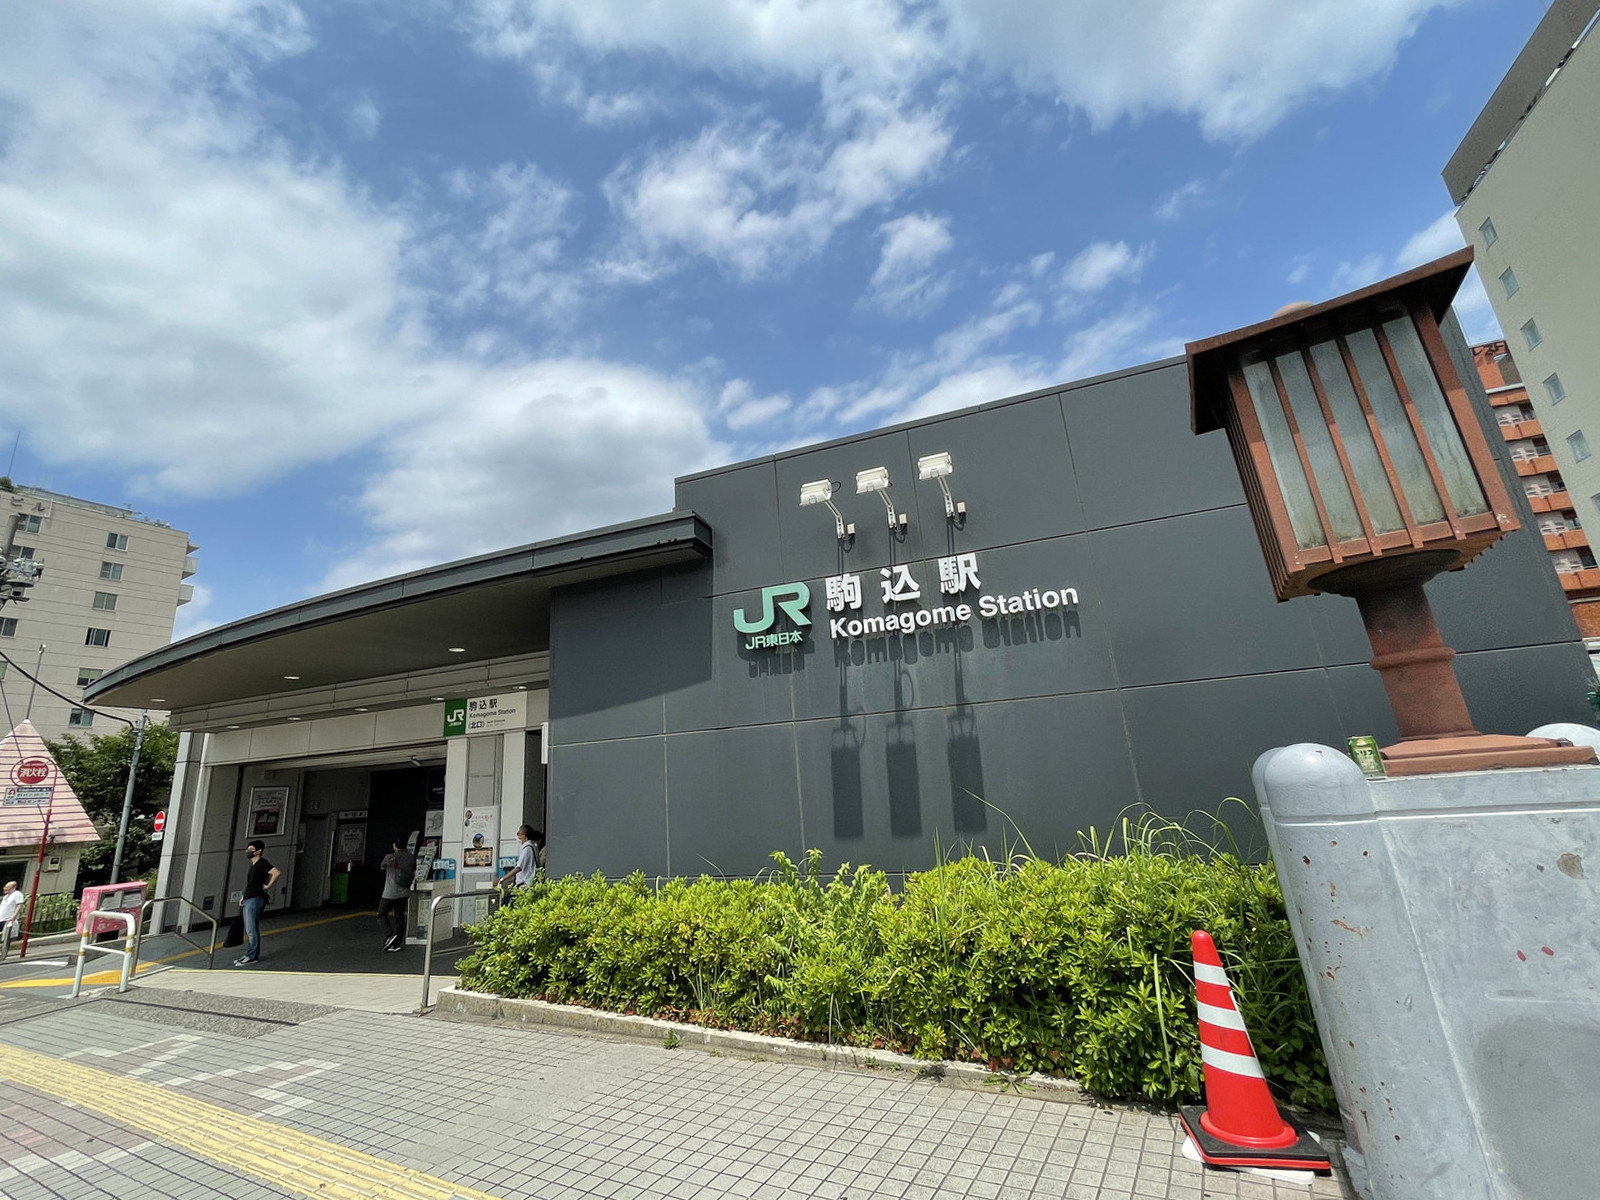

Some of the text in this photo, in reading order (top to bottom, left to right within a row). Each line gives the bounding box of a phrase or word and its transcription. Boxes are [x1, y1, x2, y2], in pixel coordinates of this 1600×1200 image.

[824, 552, 982, 613] 駒込駅
[733, 581, 812, 634] JR
[829, 587, 1079, 639] Komagome Station
[745, 630, 803, 650] JR東日本
[469, 699, 498, 711] 駒込駅
[447, 709, 465, 722] JR
[19, 768, 47, 777] 消火栓
